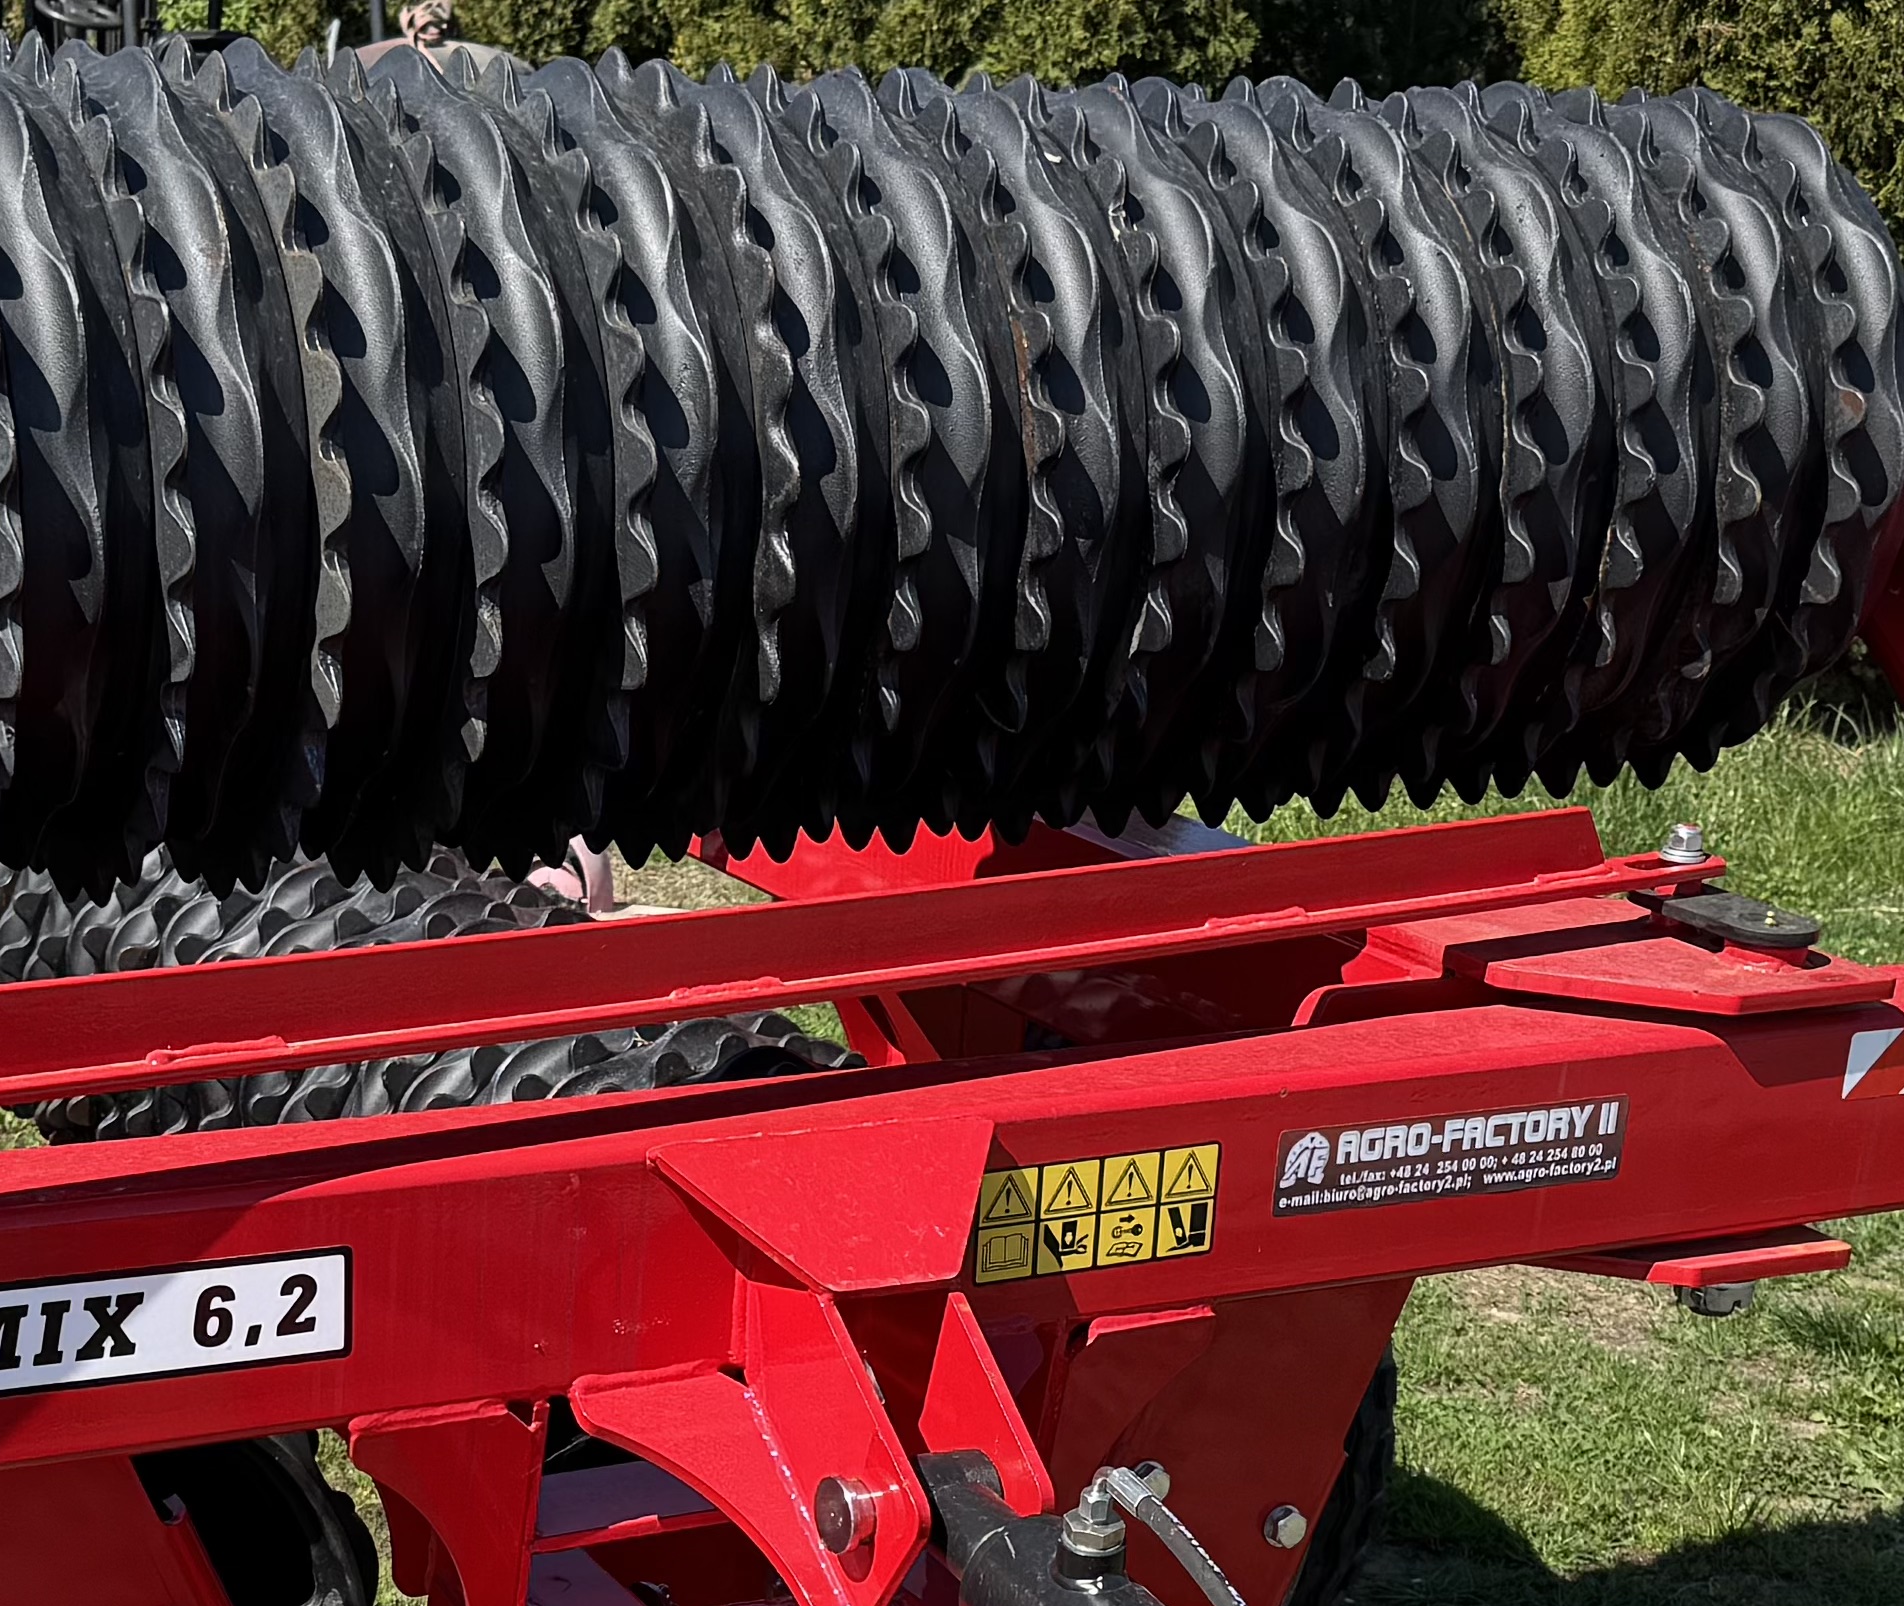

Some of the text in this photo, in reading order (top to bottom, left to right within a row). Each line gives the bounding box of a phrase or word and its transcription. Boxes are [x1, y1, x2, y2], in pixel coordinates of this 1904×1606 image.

[1336, 1101, 1619, 1164] AGRO-FACTORY II
[1414, 1163, 1429, 1177] 24
[1436, 1160, 1458, 1174] 254
[1462, 1157, 1476, 1171] 00
[1511, 1152, 1525, 1165] 48
[1528, 1150, 1543, 1163] 24
[1547, 1147, 1568, 1161] 254
[1588, 1143, 1603, 1157] 00
[1483, 1157, 1616, 1185] www.agro-factory2.pl
[192, 1273, 318, 1348] 6,2
